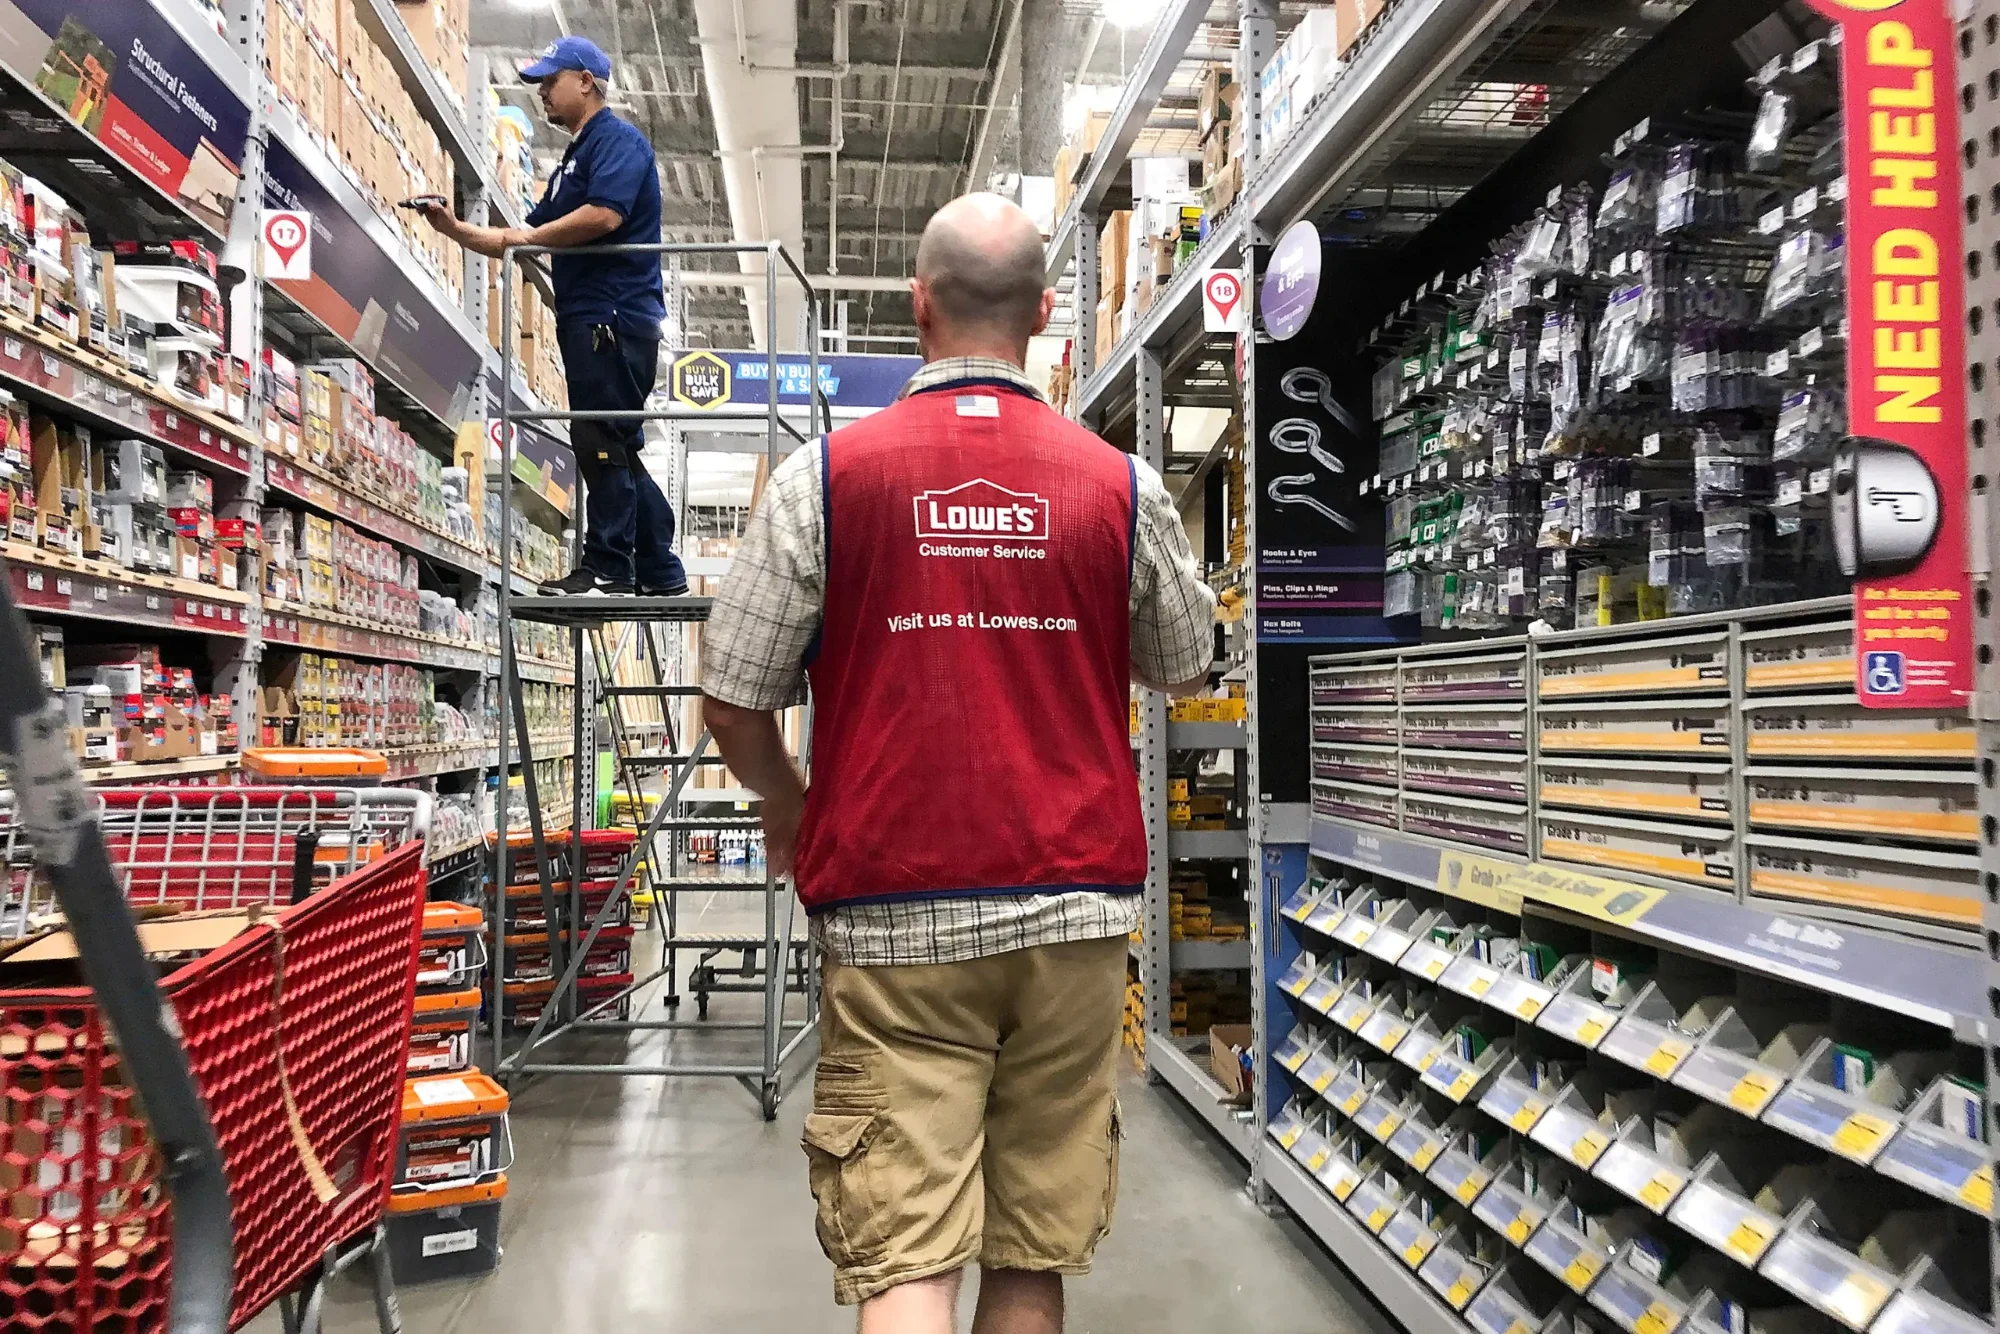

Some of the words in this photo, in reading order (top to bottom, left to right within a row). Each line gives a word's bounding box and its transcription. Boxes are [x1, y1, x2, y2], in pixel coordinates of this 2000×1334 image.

[130, 37, 179, 95] Structural
[177, 80, 219, 133] Fasteners
[1866, 20, 1939, 209] HELP
[276, 227, 296, 240] 17
[1215, 285, 1233, 297] 18
[1873, 227, 1942, 424] NEED
[685, 365, 705, 375] BUY
[708, 366, 719, 375] IN
[740, 364, 769, 378] BUY
[788, 365, 826, 379] BUK
[685, 374, 719, 386] BULK
[785, 378, 796, 393] &
[691, 386, 719, 398] SAVE
[929, 501, 1035, 533] LOWE'S
[919, 543, 990, 558] Customer
[993, 545, 1046, 560] Service
[1298, 549, 1318, 558] Eyes
[1263, 584, 1283, 593] Pins,
[1285, 584, 1306, 593] Clips
[1315, 585, 1339, 594] Rings
[887, 612, 924, 633] Visit
[928, 613, 953, 628] us
[957, 614, 975, 628] at
[979, 612, 1077, 632] Lowes.com
[1280, 620, 1302, 628] Bolts
